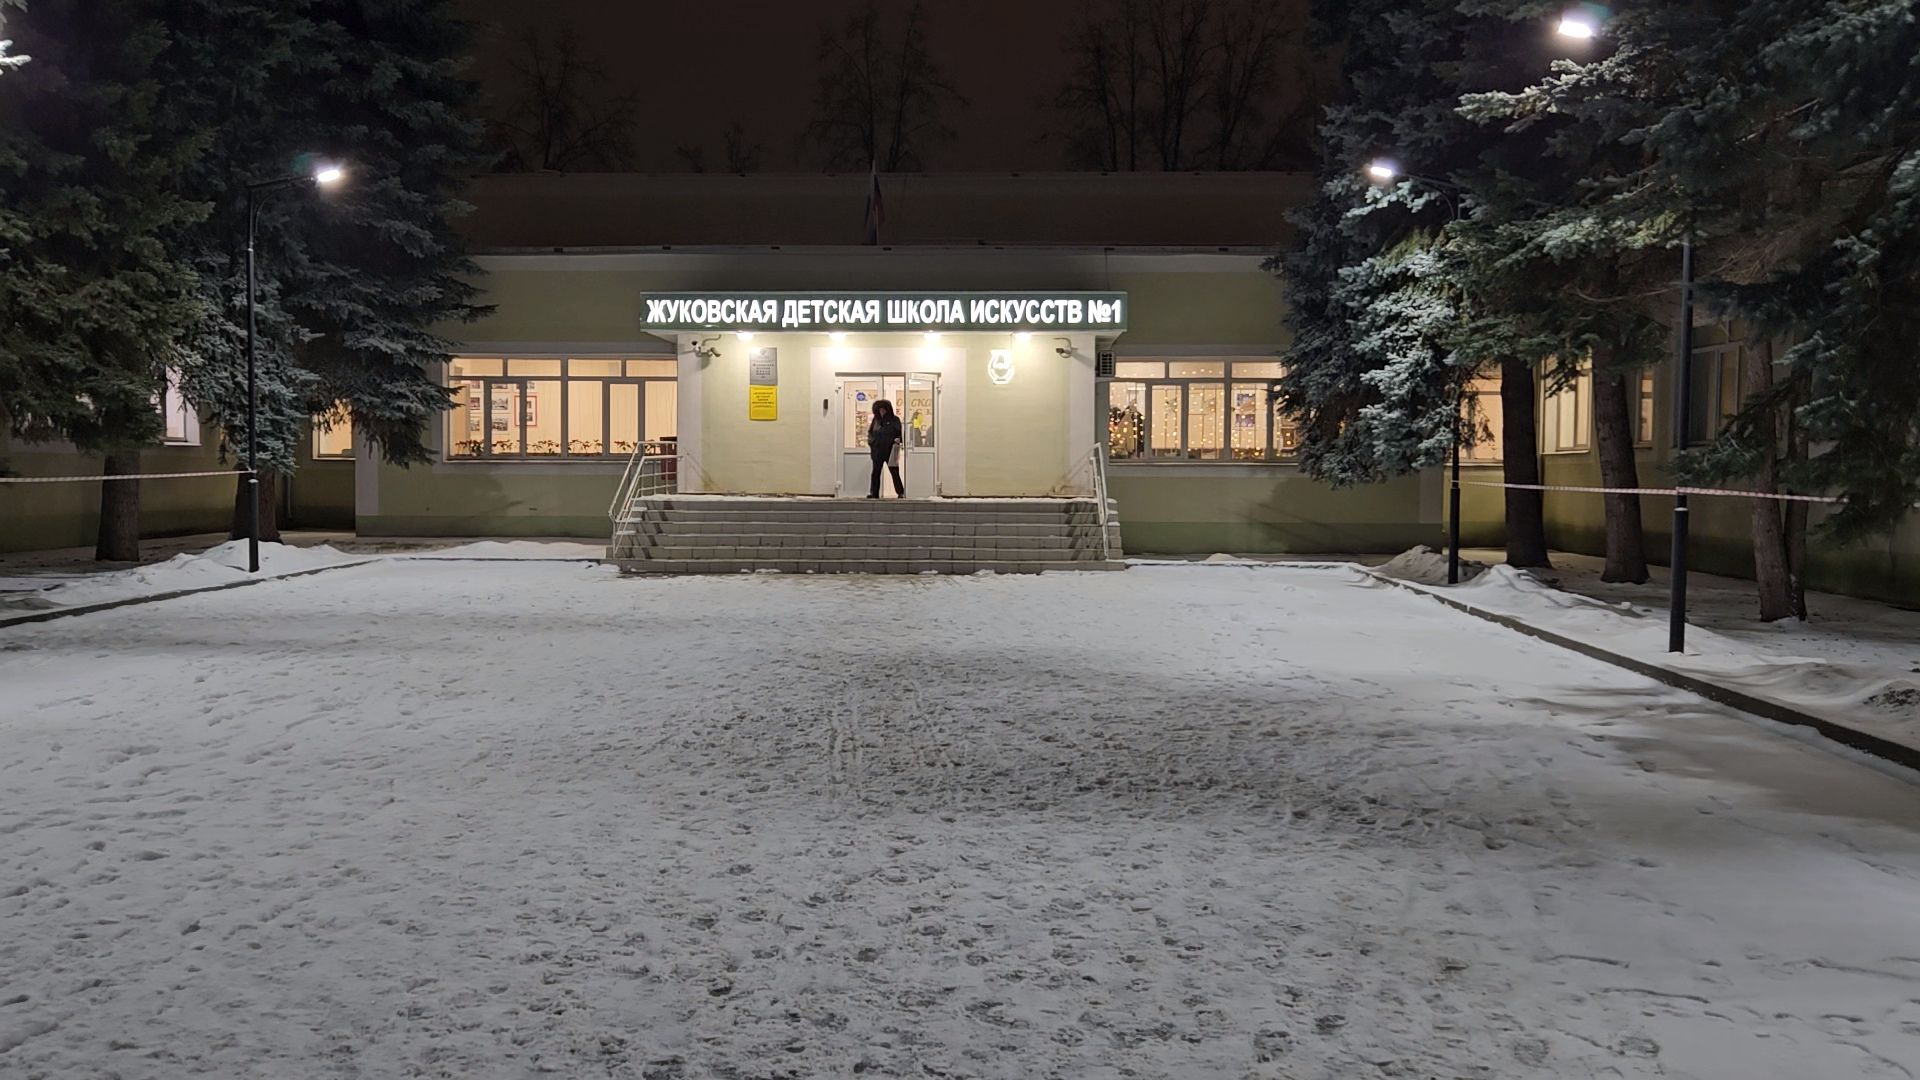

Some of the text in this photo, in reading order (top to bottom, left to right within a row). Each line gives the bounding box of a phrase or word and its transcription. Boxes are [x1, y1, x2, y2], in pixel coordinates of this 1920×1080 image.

[646, 299, 1122, 328] ЖУКОВСКАЯ ДЕТСКАЯ ШКОЛА ИСКУССТВ №1
